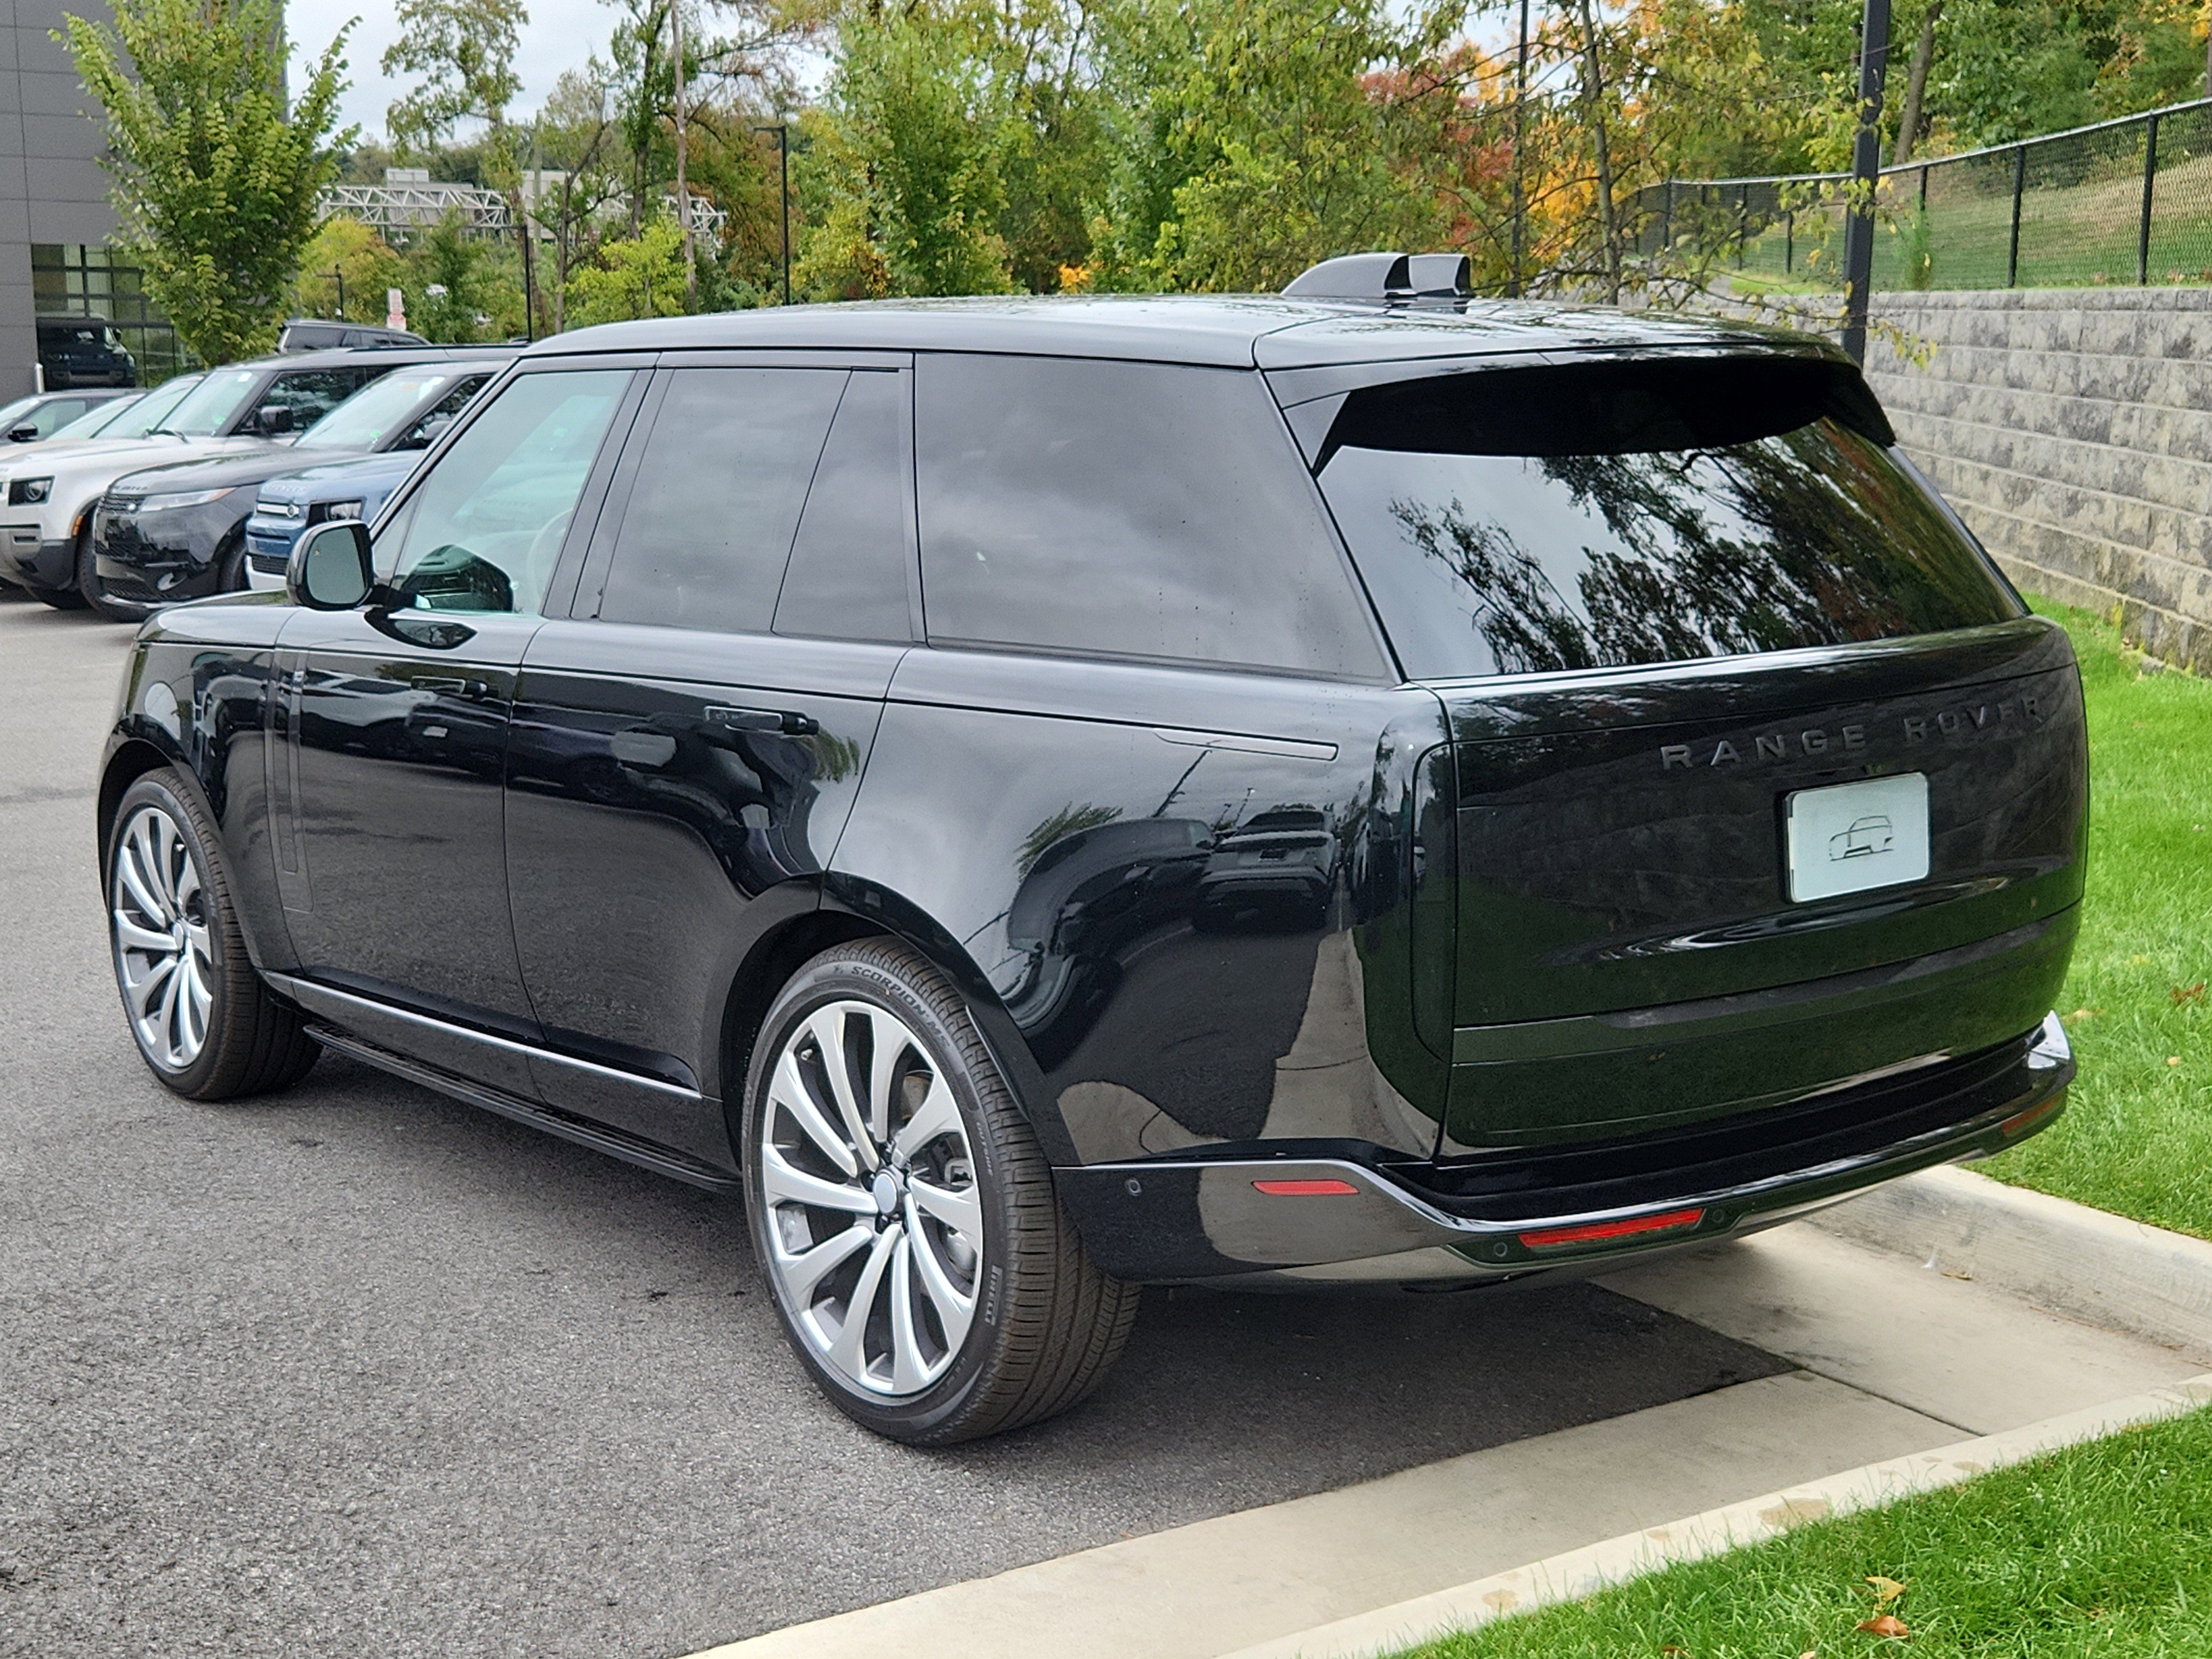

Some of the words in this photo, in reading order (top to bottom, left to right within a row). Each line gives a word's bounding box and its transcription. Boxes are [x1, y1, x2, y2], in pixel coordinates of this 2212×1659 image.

[1660, 724, 1866, 770] RANGE
[1903, 696, 2044, 740] ROVER
[851, 966, 926, 1017] SCORPION
[985, 1264, 1003, 1326] PIRELLI
